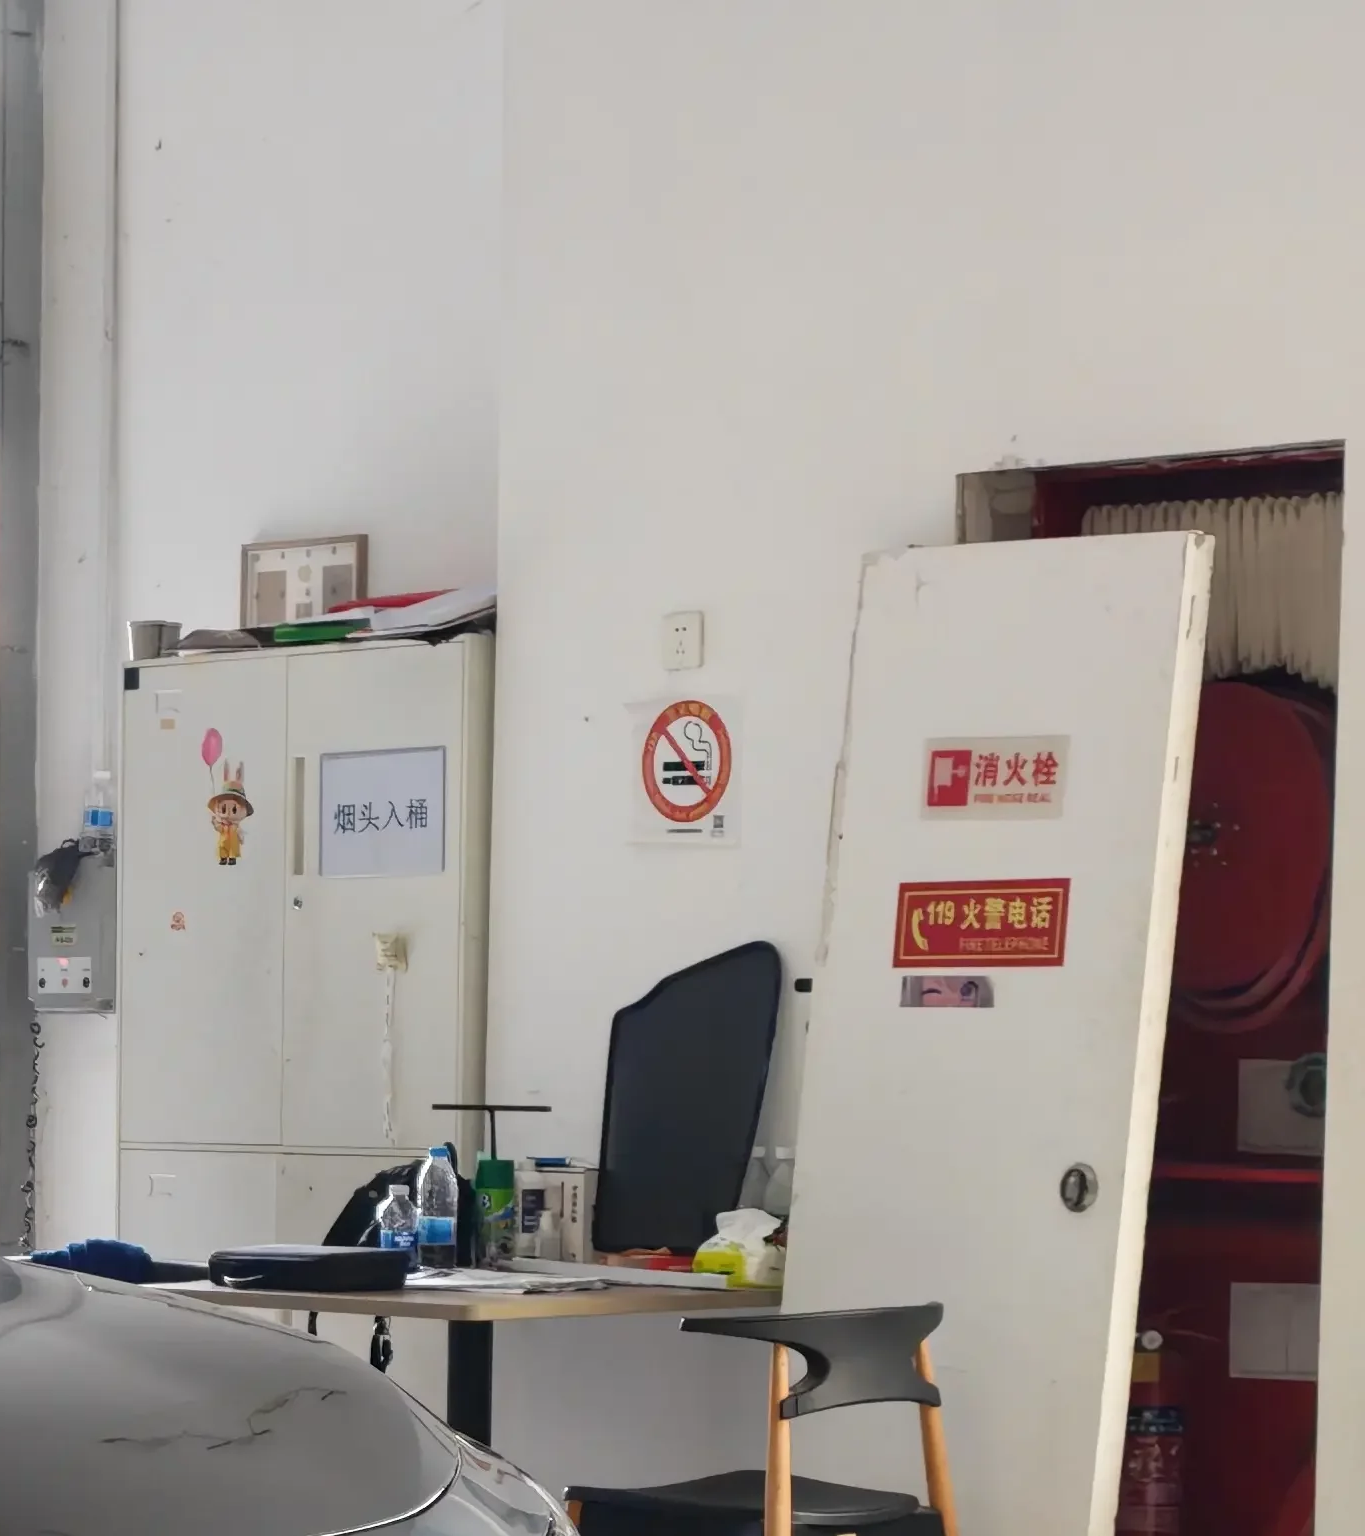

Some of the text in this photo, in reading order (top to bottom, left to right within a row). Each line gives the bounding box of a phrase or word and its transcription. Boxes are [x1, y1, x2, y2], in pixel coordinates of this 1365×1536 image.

[974, 752, 1059, 787] 消火栓
[333, 798, 428, 835] 烟头入桶
[927, 896, 1054, 931] 119 火警电话
